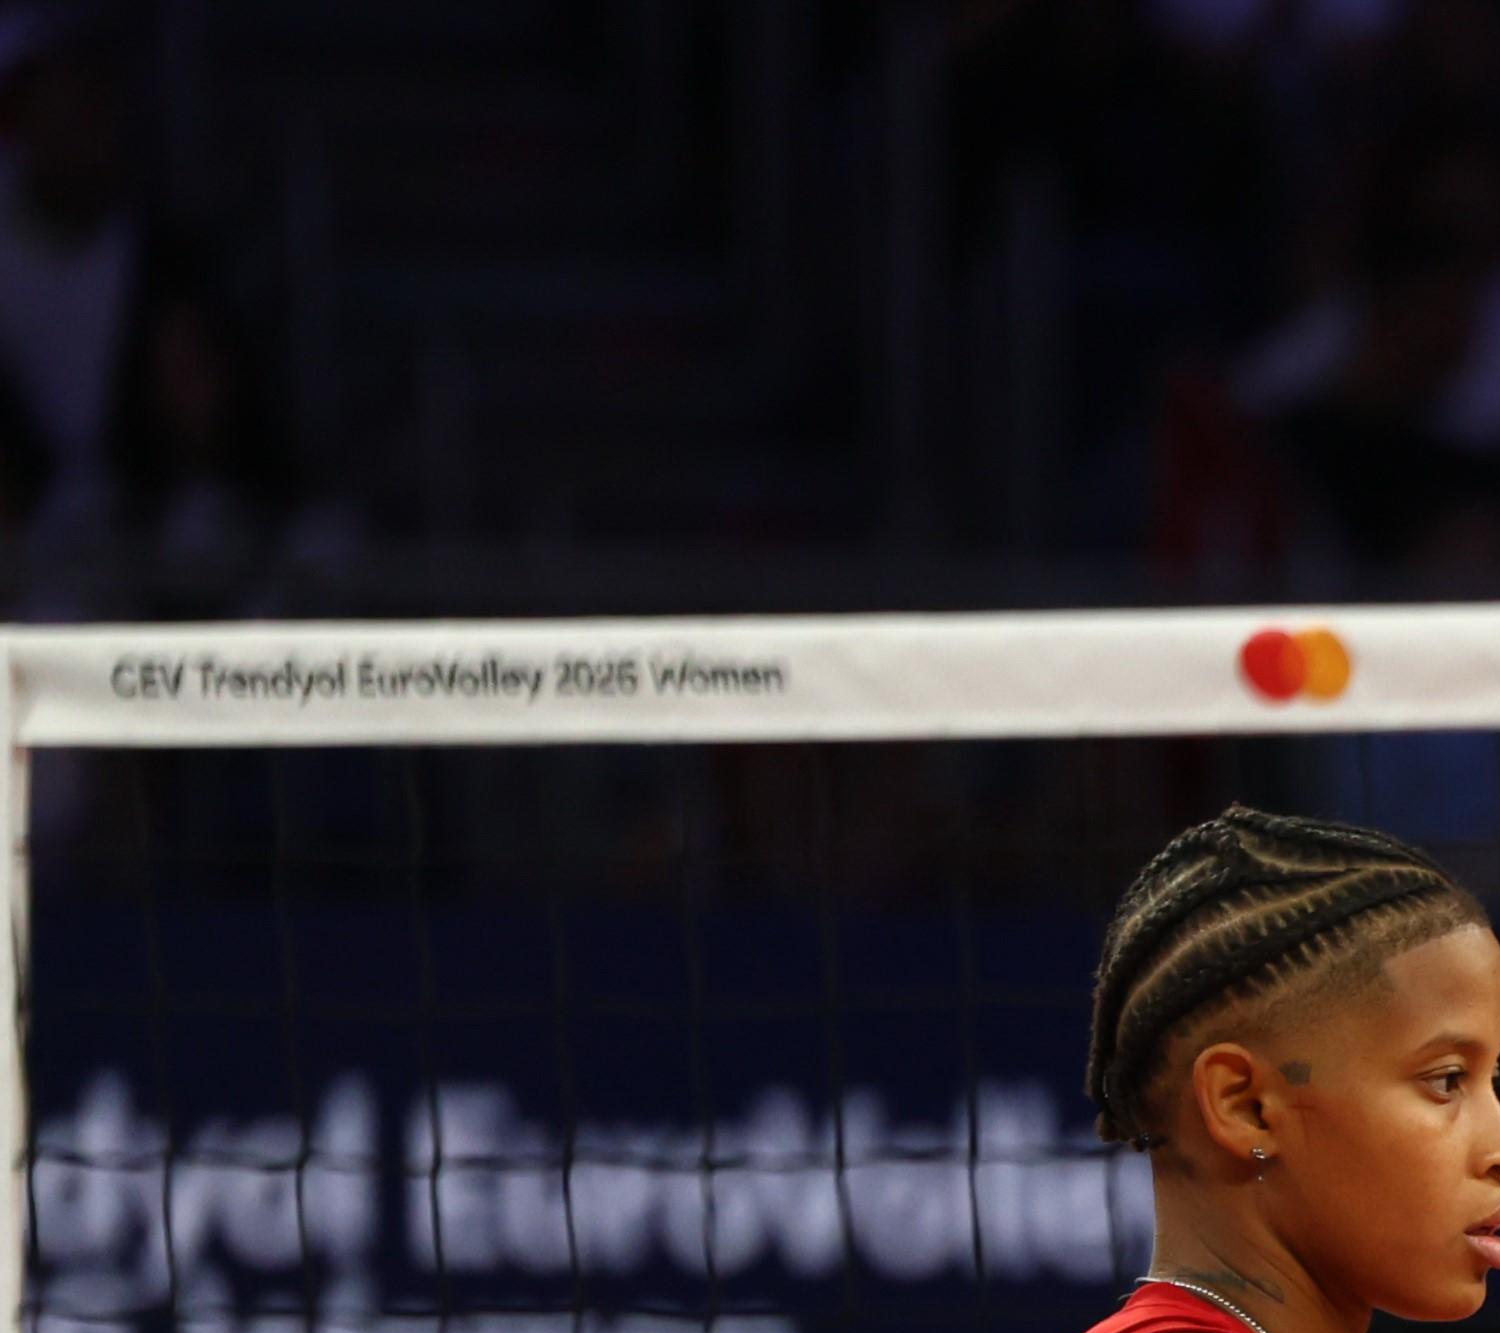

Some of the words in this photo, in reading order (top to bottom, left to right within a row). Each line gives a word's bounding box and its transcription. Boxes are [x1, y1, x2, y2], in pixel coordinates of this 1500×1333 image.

[109, 654, 186, 699] CEV
[196, 654, 346, 708] Trendyol
[356, 652, 543, 704] EuroVolley
[554, 653, 640, 697] 2026
[647, 652, 787, 696] Women
